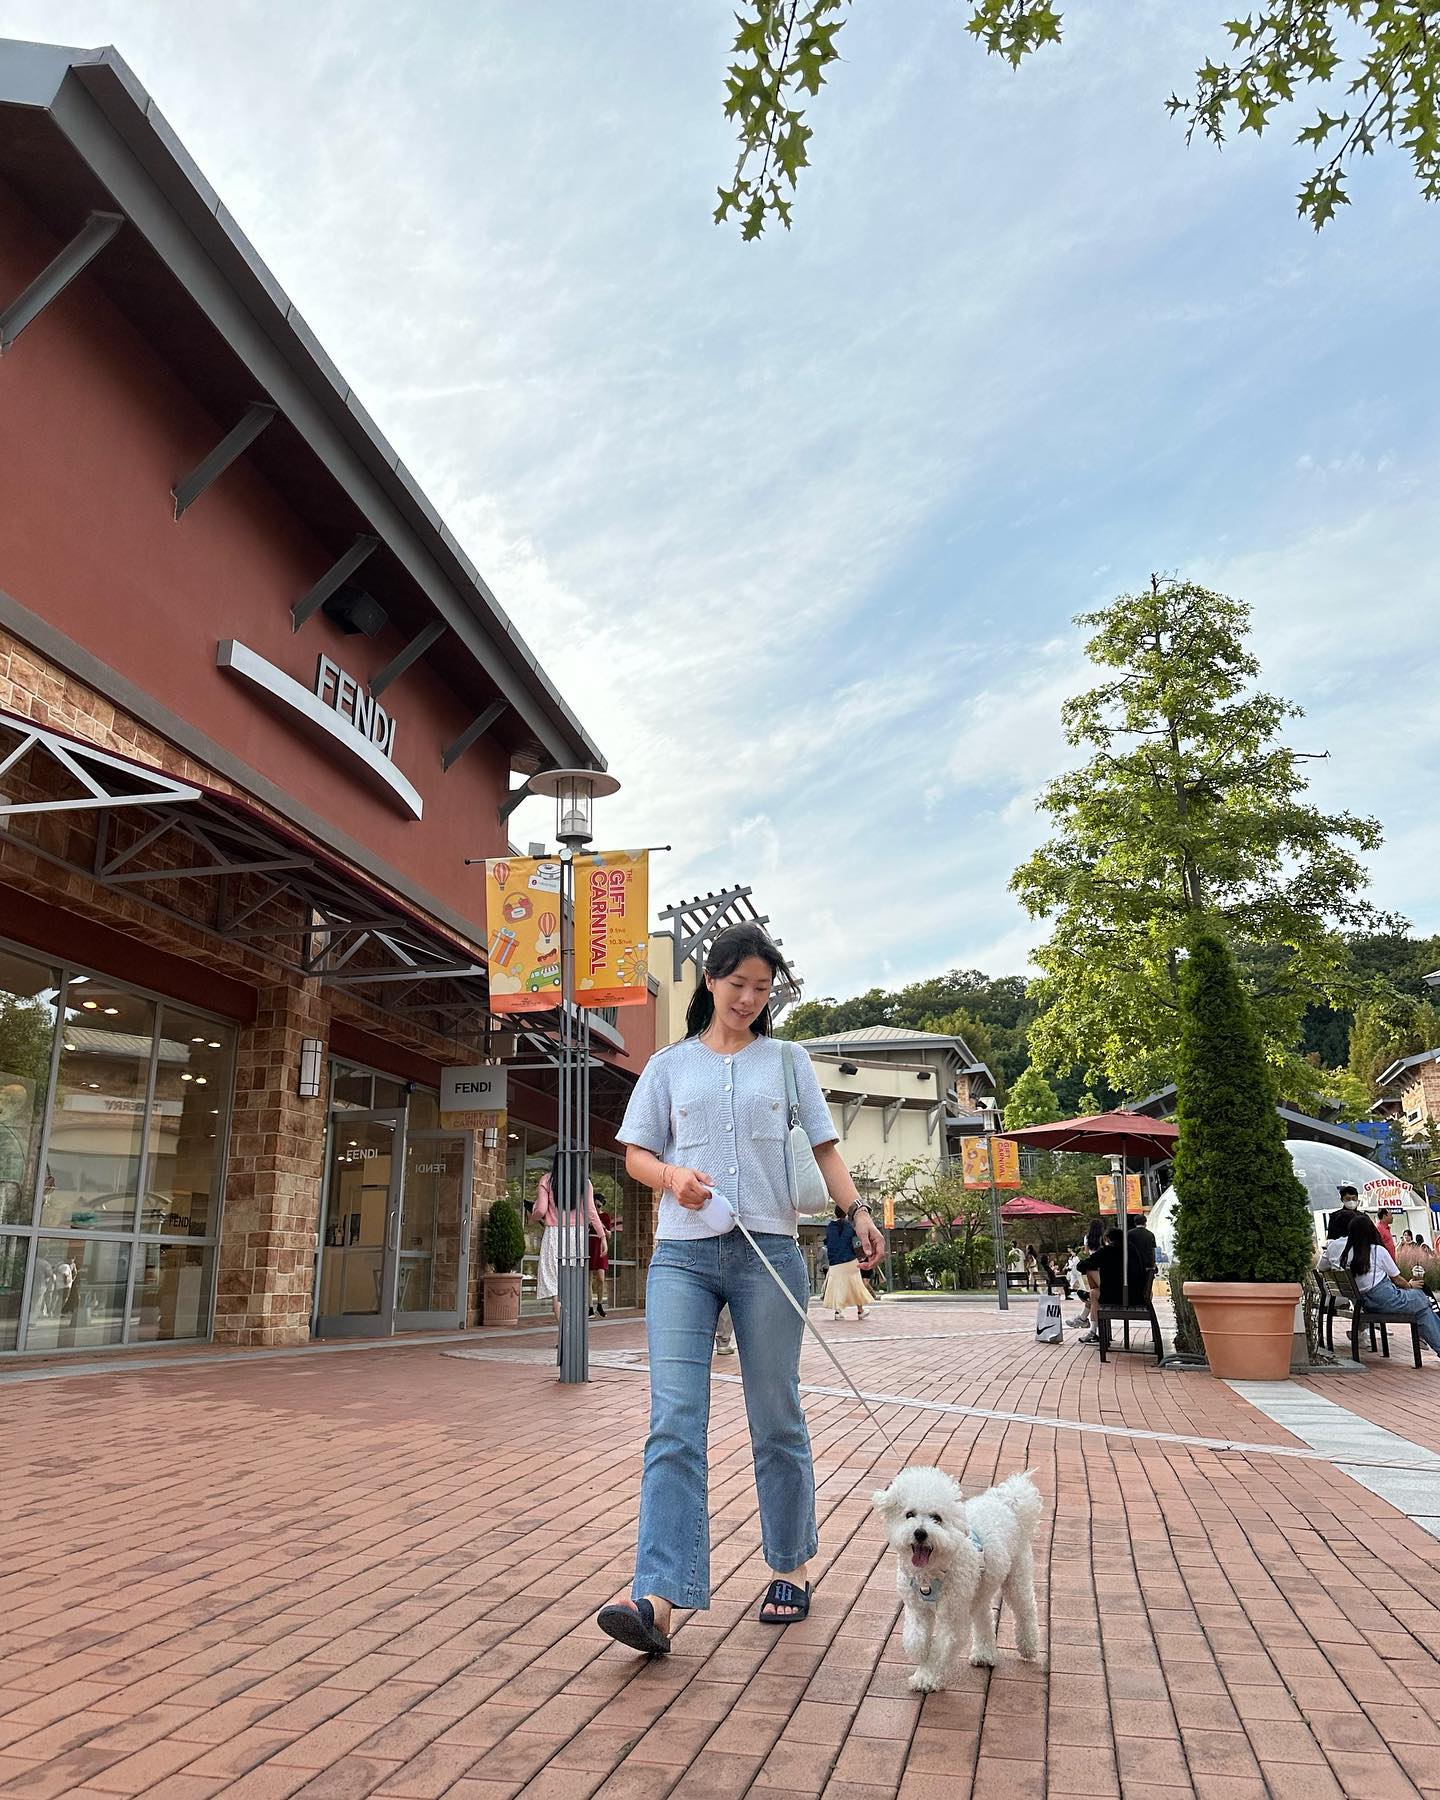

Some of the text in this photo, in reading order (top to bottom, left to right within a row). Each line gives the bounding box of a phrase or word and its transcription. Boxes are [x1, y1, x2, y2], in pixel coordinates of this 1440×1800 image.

[316, 653, 396, 760] FENDI
[609, 868, 626, 918] GIFT
[590, 869, 608, 975] CARNIVAL
[455, 1082, 492, 1094] FENDI
[346, 1148, 379, 1160] FENDI
[1364, 1179, 1412, 1192] GYEONGGI
[1377, 1199, 1403, 1207] LAND
[168, 1215, 192, 1229] FENDI
